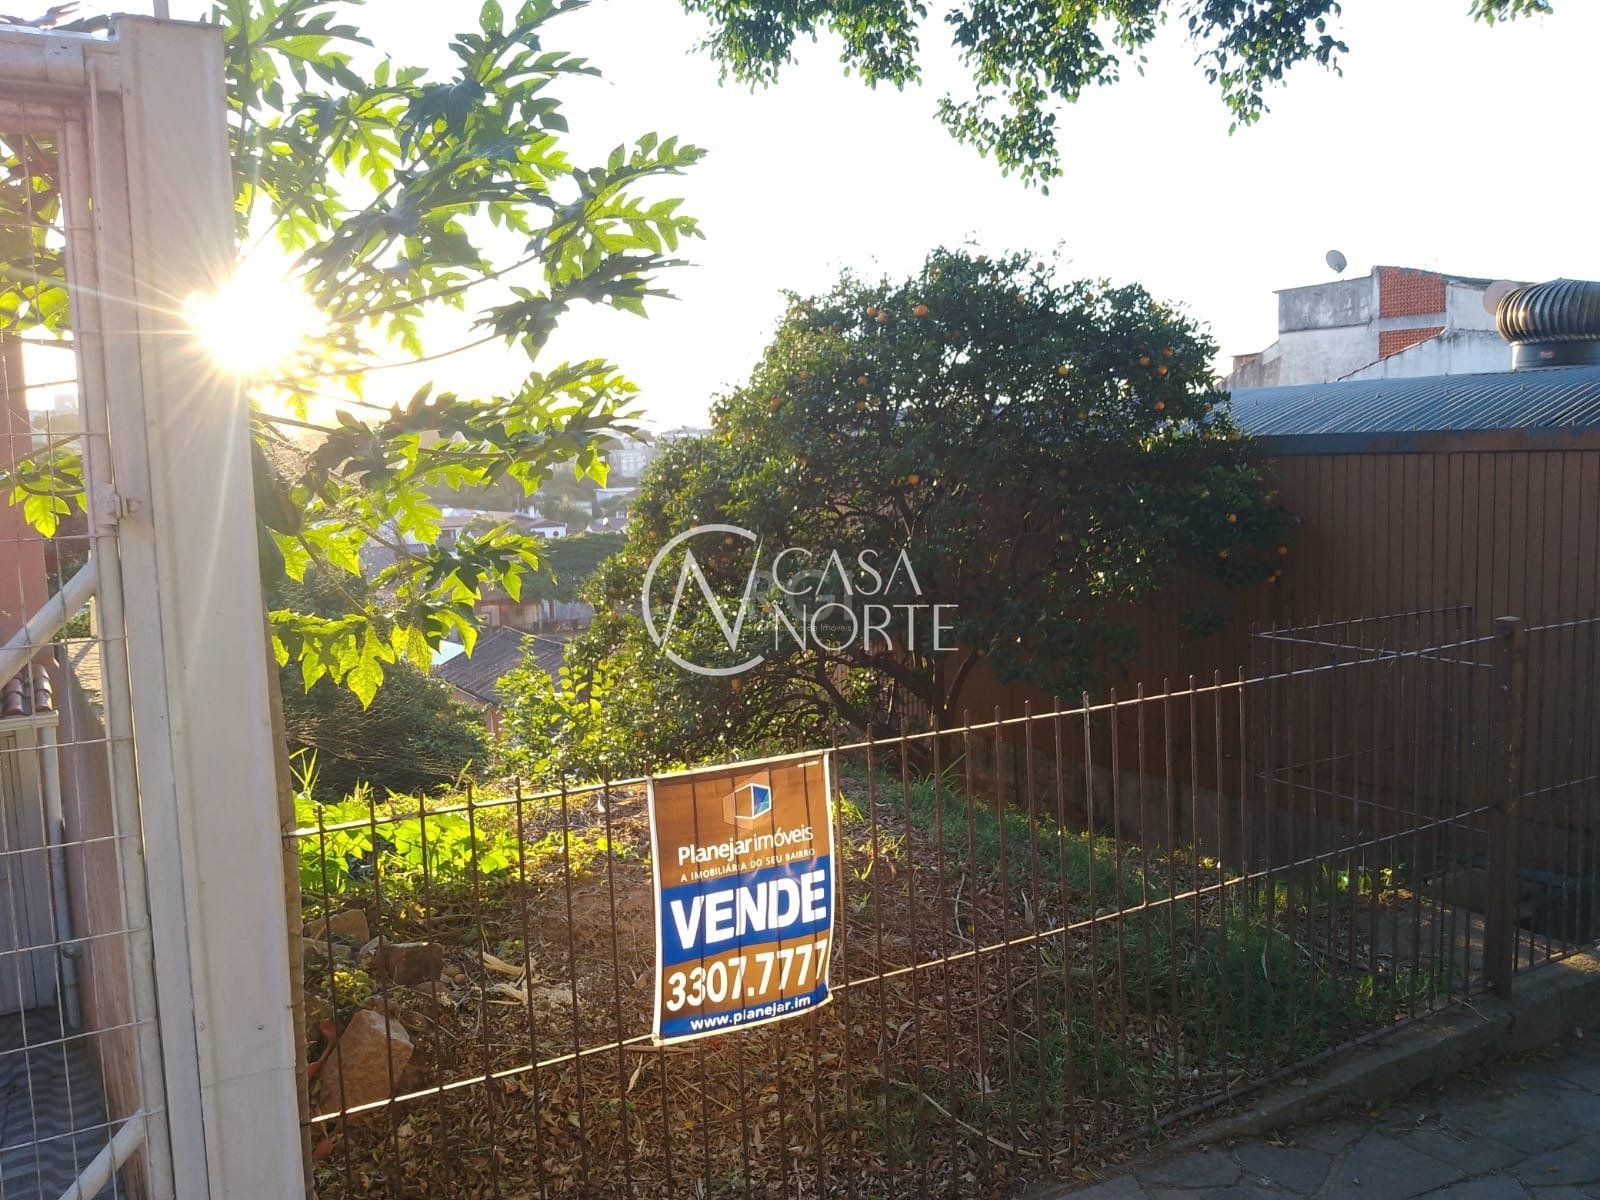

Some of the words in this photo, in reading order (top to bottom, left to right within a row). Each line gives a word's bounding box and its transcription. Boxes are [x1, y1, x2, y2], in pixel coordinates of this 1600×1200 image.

[680, 873, 688, 883] A
[690, 862, 747, 881] IMOBILIÁRIA
[750, 859, 763, 869] DO
[765, 855, 782, 866] SEU
[785, 848, 815, 861] BAIRRO
[670, 869, 826, 950] VENDE
[666, 938, 828, 1012] 3307.7777
[690, 995, 811, 1031] www.planejar.im
